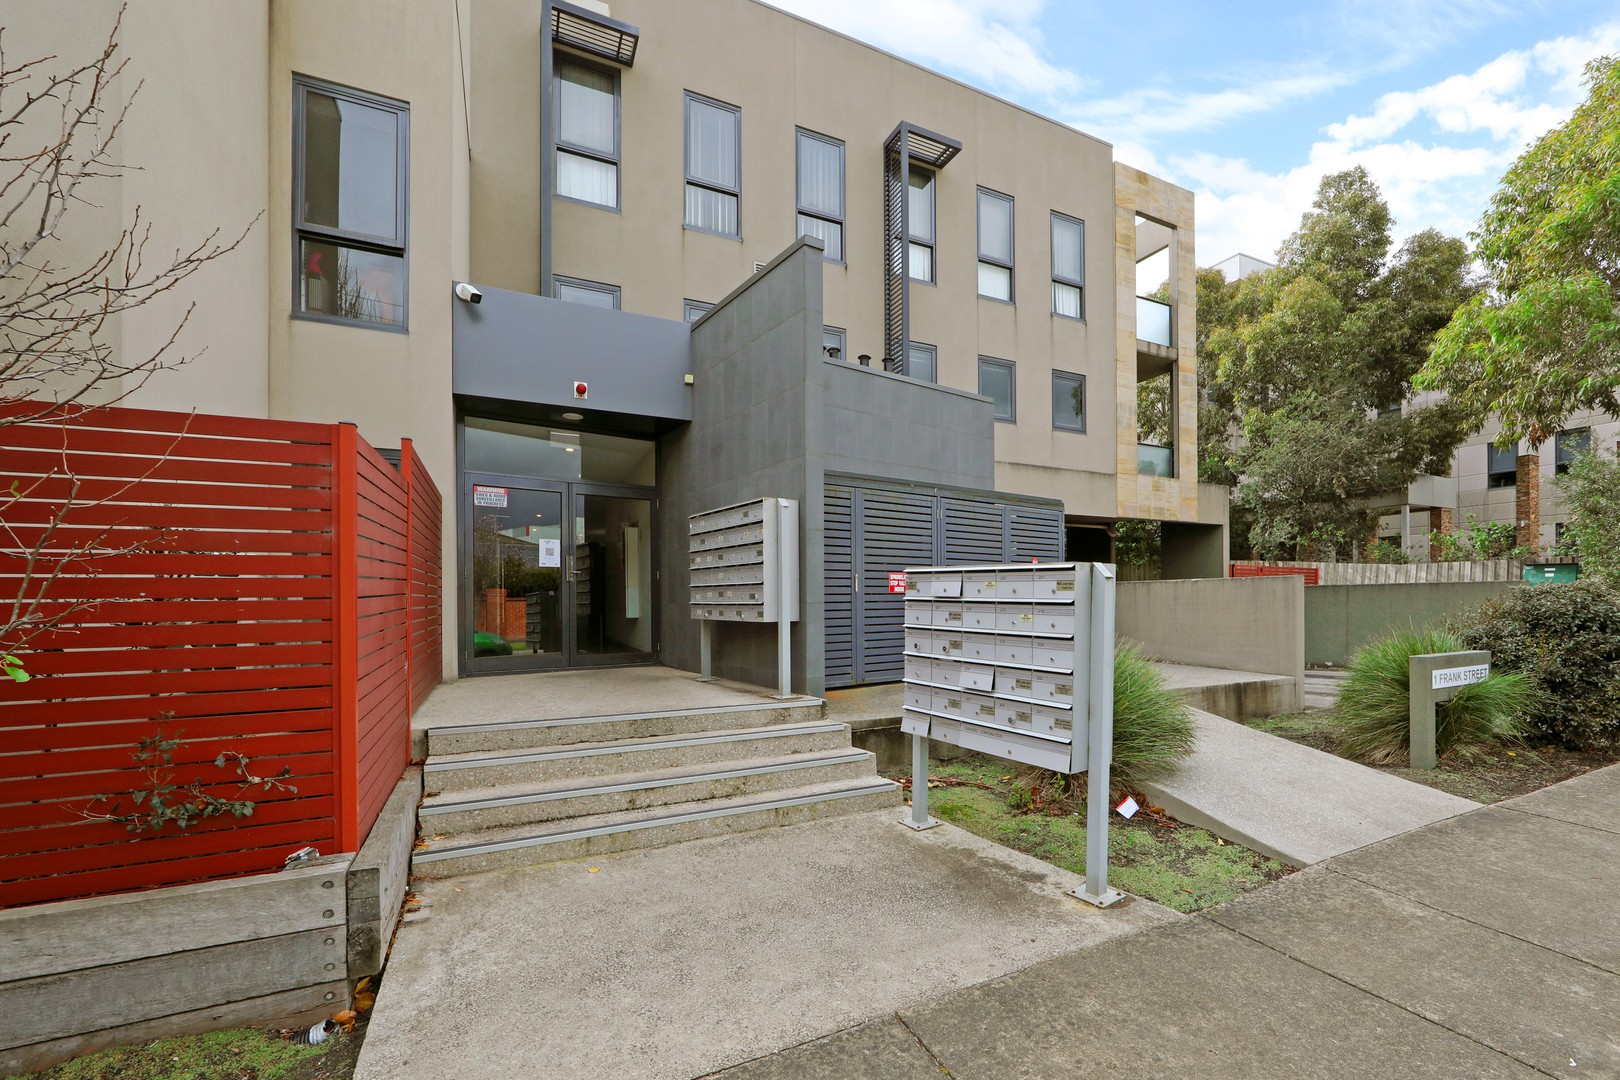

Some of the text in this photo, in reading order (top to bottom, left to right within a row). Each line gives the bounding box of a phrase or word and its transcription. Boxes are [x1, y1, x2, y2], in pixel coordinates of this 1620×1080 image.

[1433, 668, 1488, 684] 1 FRANK STREET
